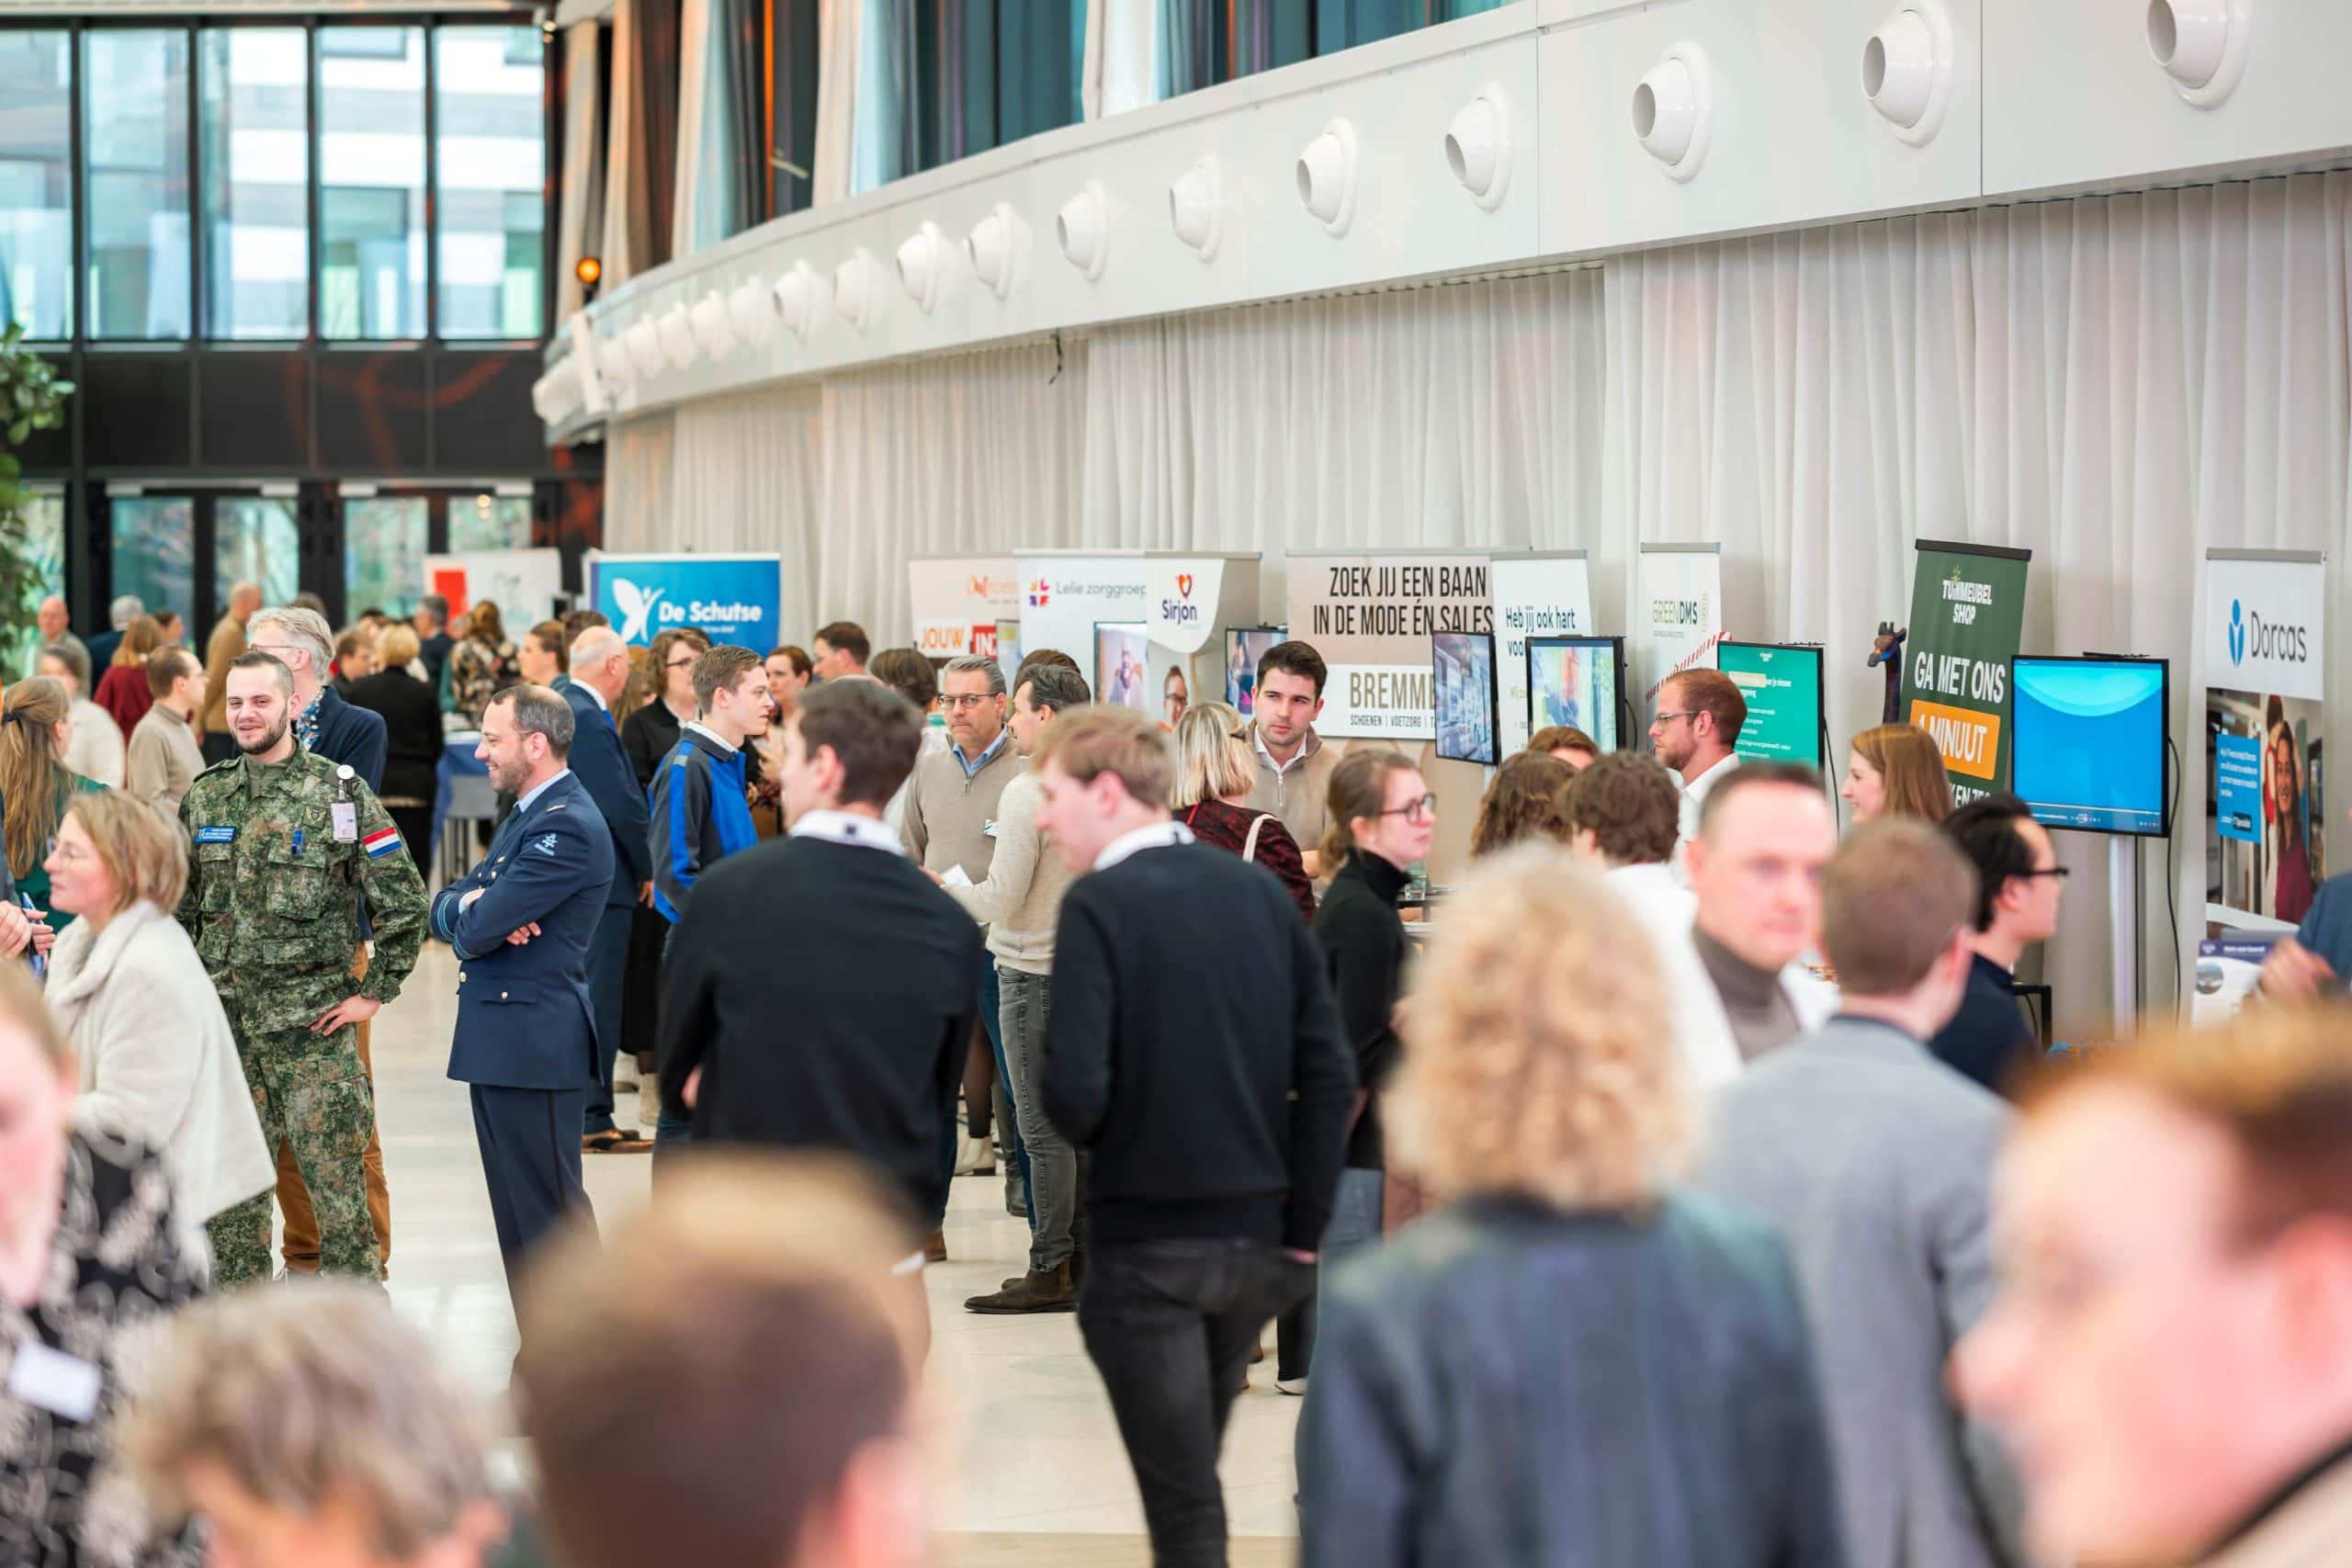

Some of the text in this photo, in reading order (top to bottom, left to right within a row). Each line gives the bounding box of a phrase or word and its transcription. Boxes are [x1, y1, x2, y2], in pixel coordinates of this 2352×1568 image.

[1057, 581, 1147, 600] Lelie zorggroep
[1329, 566, 1486, 597] ZOEK JIJ EEN BAAN
[659, 600, 763, 623] De Schutse
[1161, 600, 1198, 626] Sirjon
[1314, 599, 1494, 636] IN DE MODE ÉN SALES
[1505, 605, 1577, 633] Heb jij ook hart
[1952, 603, 1977, 626] SHOP
[920, 626, 998, 659] JOUW IN
[1507, 640, 1525, 657] voo
[2250, 610, 2307, 663] Dorcas
[1914, 650, 2007, 705] GA MET ONS
[1350, 714, 1383, 727] SCHOENEN
[1928, 714, 1989, 765] MINUUT
